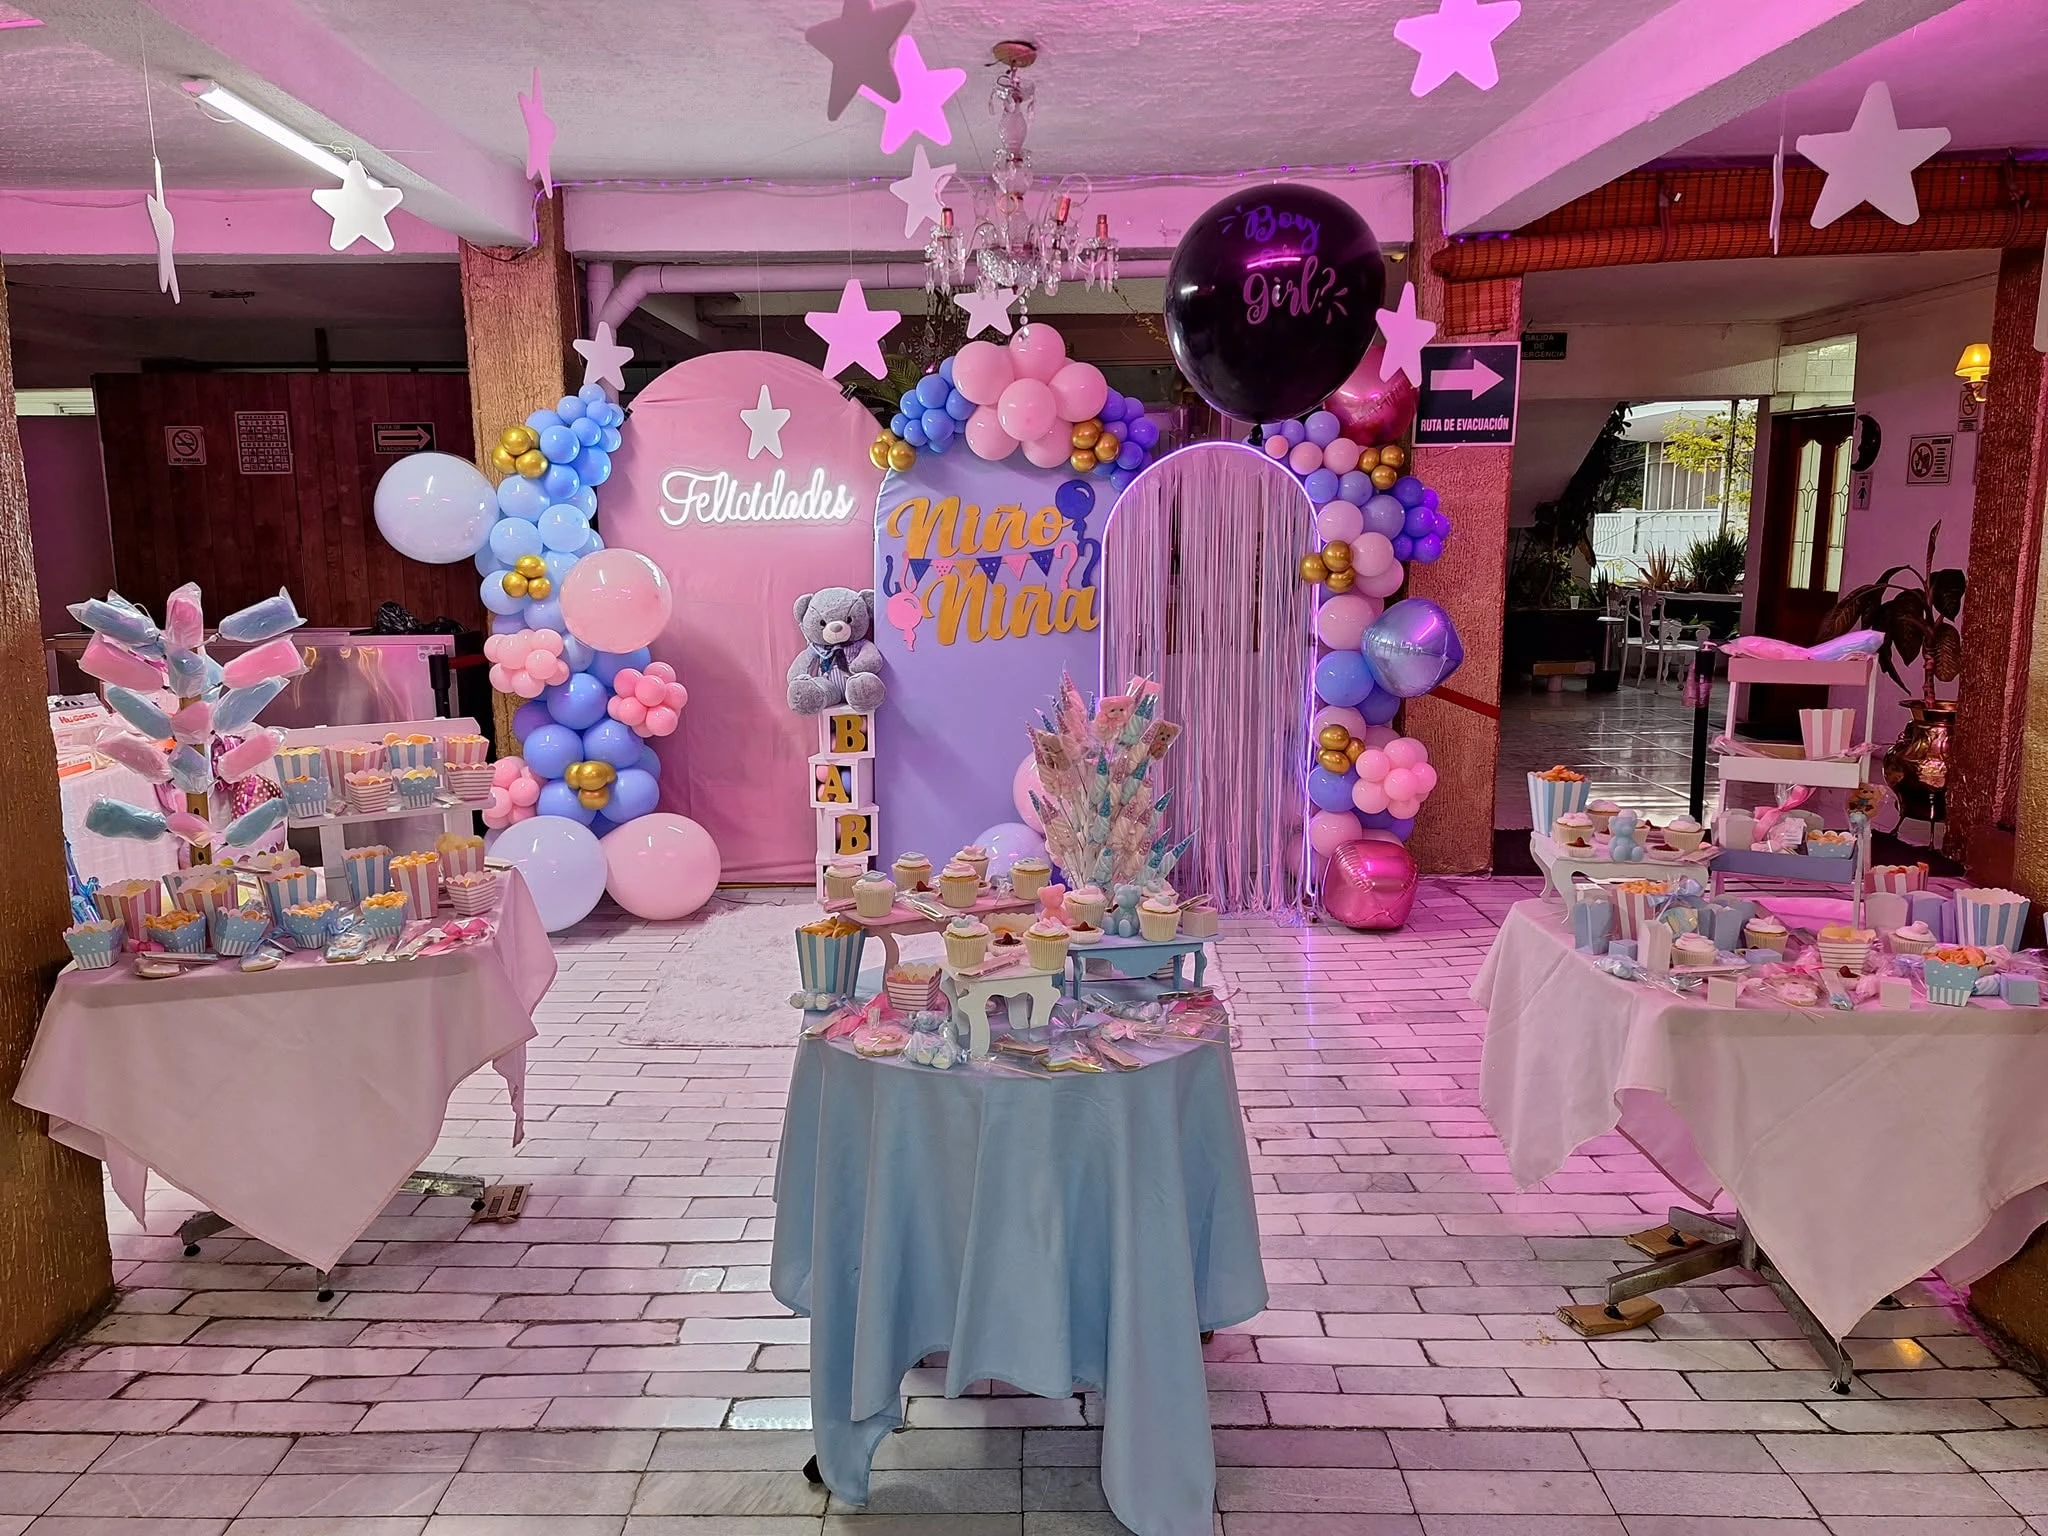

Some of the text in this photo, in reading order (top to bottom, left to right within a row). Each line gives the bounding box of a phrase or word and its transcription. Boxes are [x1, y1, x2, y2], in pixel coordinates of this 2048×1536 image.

[1243, 205, 1320, 254] Boy
[1243, 255, 1336, 324] girl?
[1420, 414, 1510, 431] RUTA DE EVACUACIÓN
[659, 468, 855, 526] Felicidades
[886, 496, 1075, 560] Niño
[922, 572, 1100, 647] Niña
